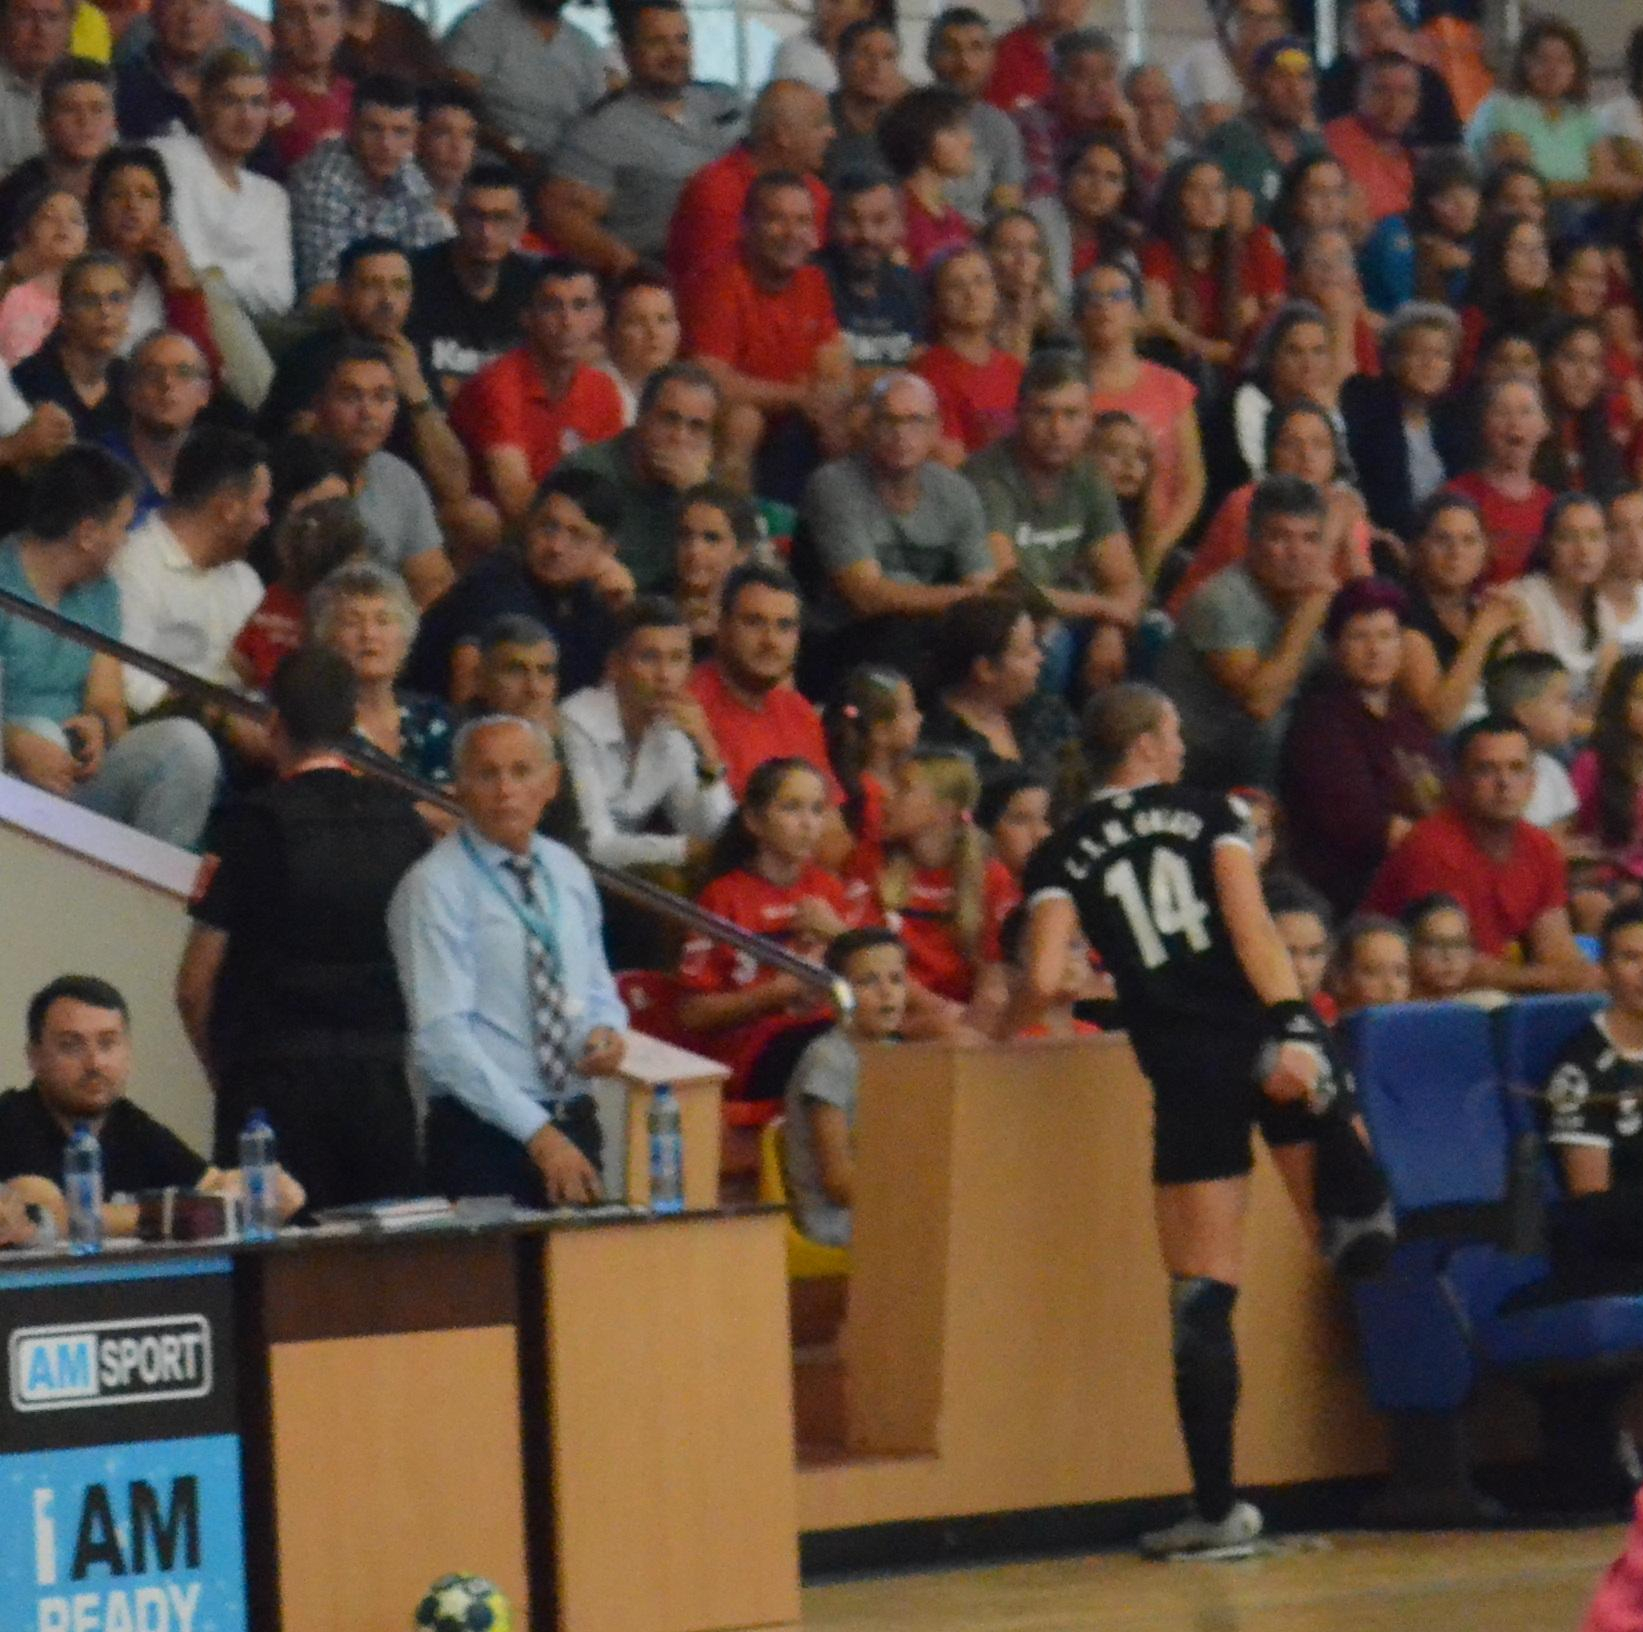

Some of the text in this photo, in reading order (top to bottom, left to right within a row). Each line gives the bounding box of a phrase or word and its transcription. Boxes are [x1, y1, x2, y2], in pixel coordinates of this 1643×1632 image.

[1103, 846, 1212, 969] 14
[28, 1333, 200, 1391] AM SPORT
[69, 1474, 201, 1582] AM
